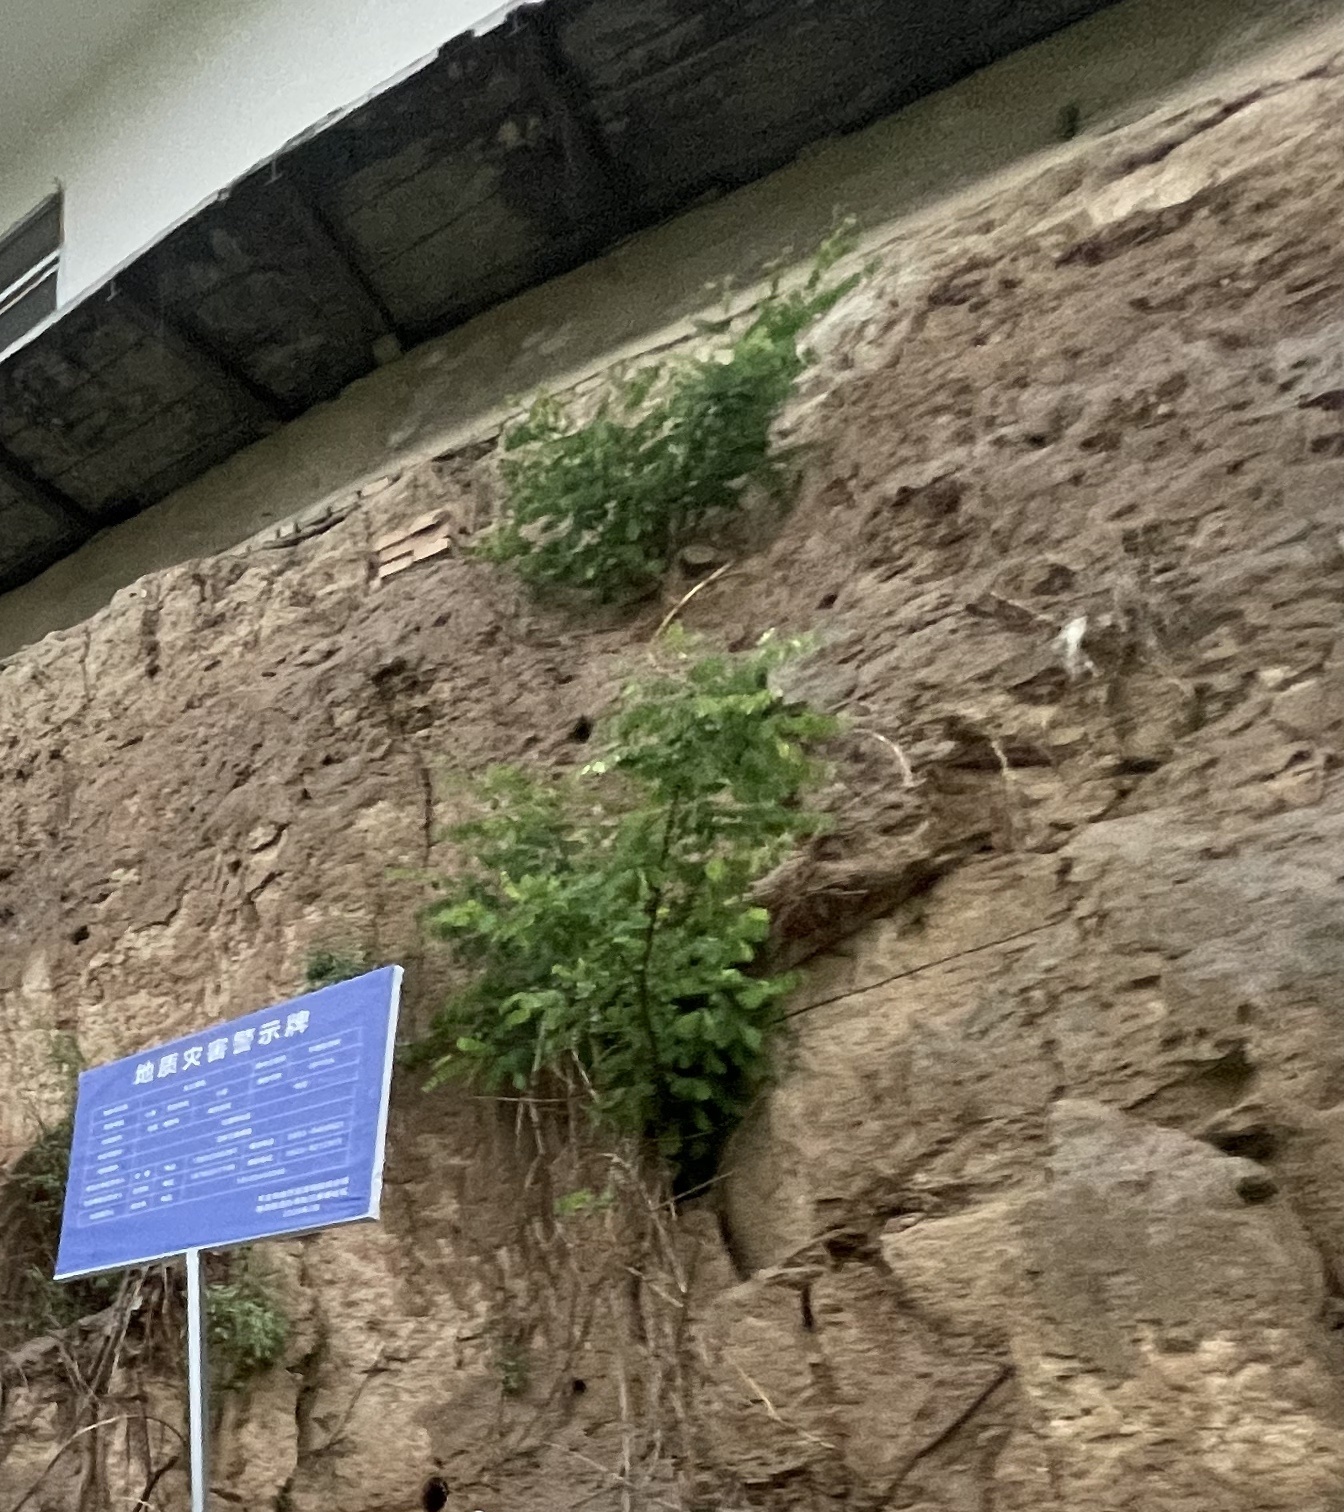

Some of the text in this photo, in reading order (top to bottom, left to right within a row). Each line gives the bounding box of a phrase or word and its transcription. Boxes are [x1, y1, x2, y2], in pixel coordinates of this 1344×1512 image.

[133, 1010, 310, 1085] 地质灾害警示牌
